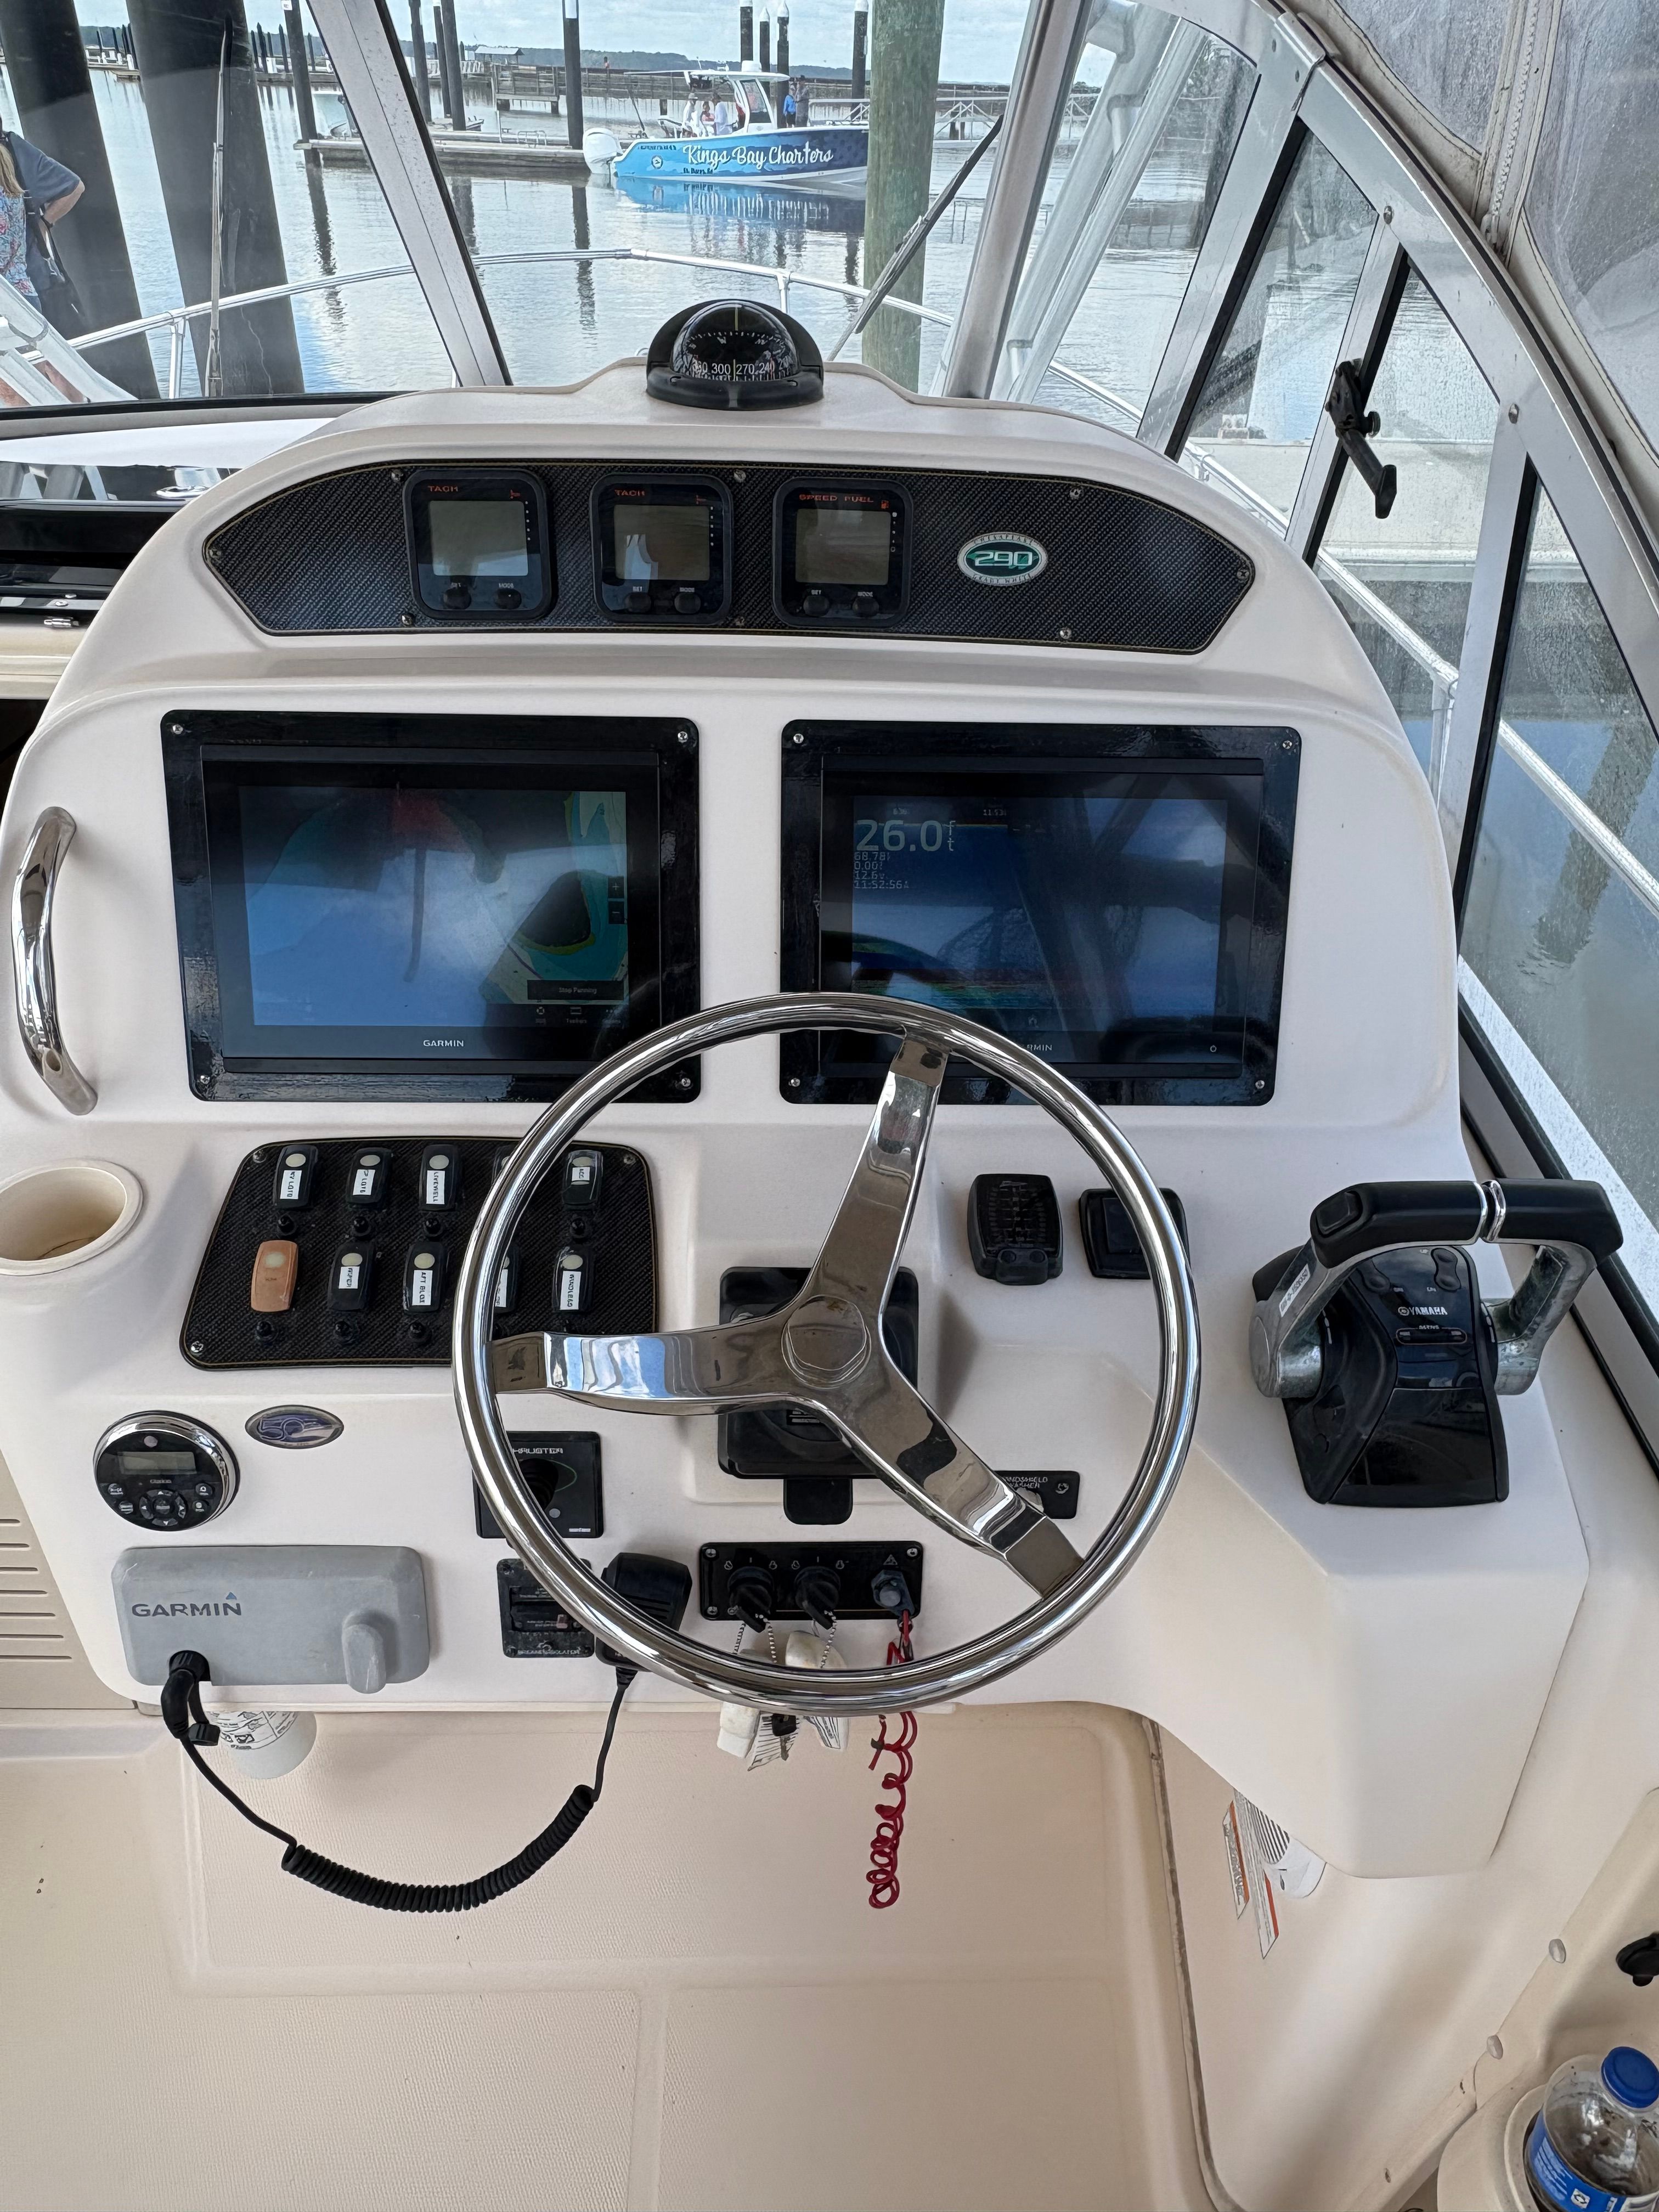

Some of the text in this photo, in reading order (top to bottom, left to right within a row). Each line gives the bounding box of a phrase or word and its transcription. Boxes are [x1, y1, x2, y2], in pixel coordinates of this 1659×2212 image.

[683, 141, 833, 171] Kings Bay Charters
[712, 363, 731, 375] 300
[736, 363, 755, 375] 270
[974, 551, 1032, 566] 290
[856, 820, 943, 851] 26.0
[1409, 1306, 1448, 1316] YAMAHA
[131, 1603, 242, 1617] GARMIN
